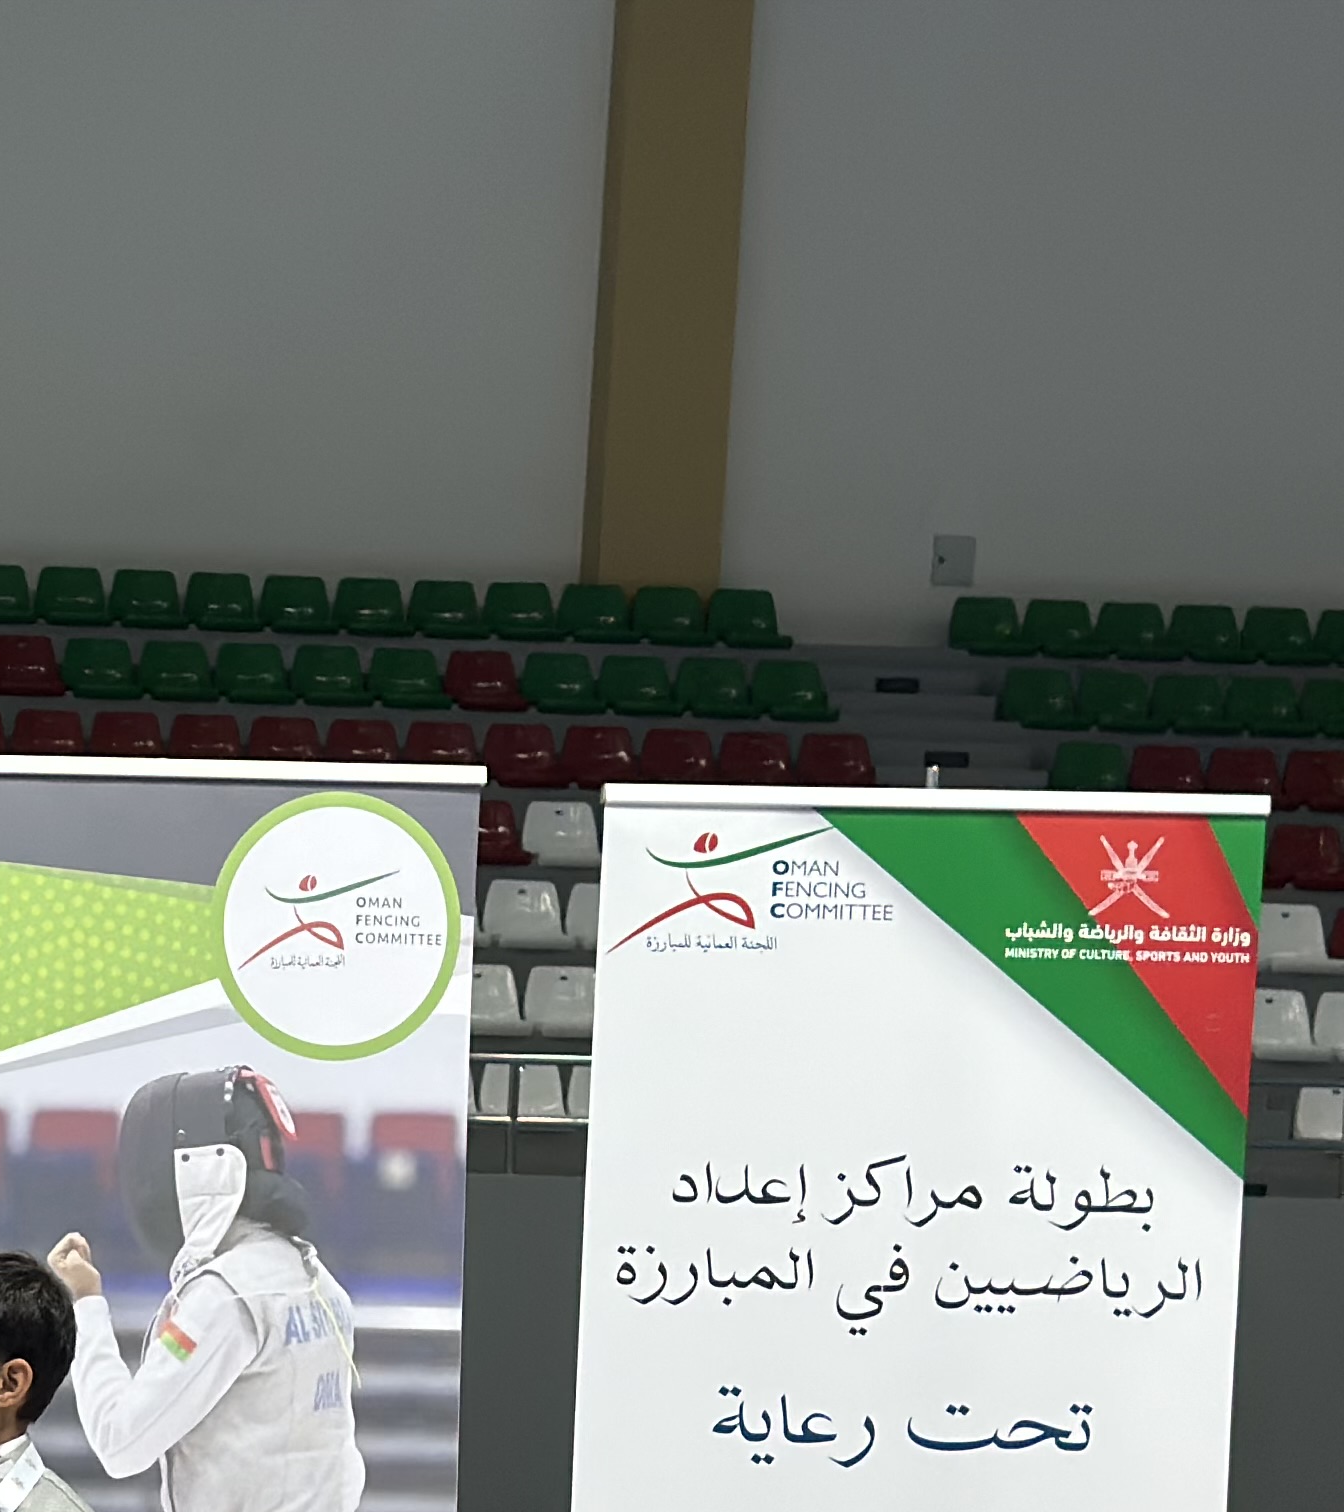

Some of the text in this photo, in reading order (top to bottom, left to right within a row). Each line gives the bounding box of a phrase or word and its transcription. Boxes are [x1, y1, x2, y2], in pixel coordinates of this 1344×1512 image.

[772, 860, 839, 876] OMAN
[771, 881, 866, 899] FENCING
[356, 896, 402, 908] OMAN
[356, 914, 420, 927] FENCING
[770, 903, 893, 921] COMMITTEE
[355, 932, 442, 946] COMMITTEE
[1005, 920, 1251, 947] وزارة الثقافة والرياضة والشباب
[646, 933, 777, 955] اللجنة العمانية للمبارزة
[1005, 948, 1058, 959] MINISTRY
[1061, 948, 1077, 959] OF
[1136, 951, 1181, 962] SPORTS
[1183, 952, 1208, 963] AND
[1211, 952, 1250, 964] YOUTH
[672, 1154, 1154, 1233] بطولة مراكز إعداد
[616, 1244, 1202, 1336] الرياضيين في المبارزة
[712, 1386, 1093, 1468] تحت رعاية
